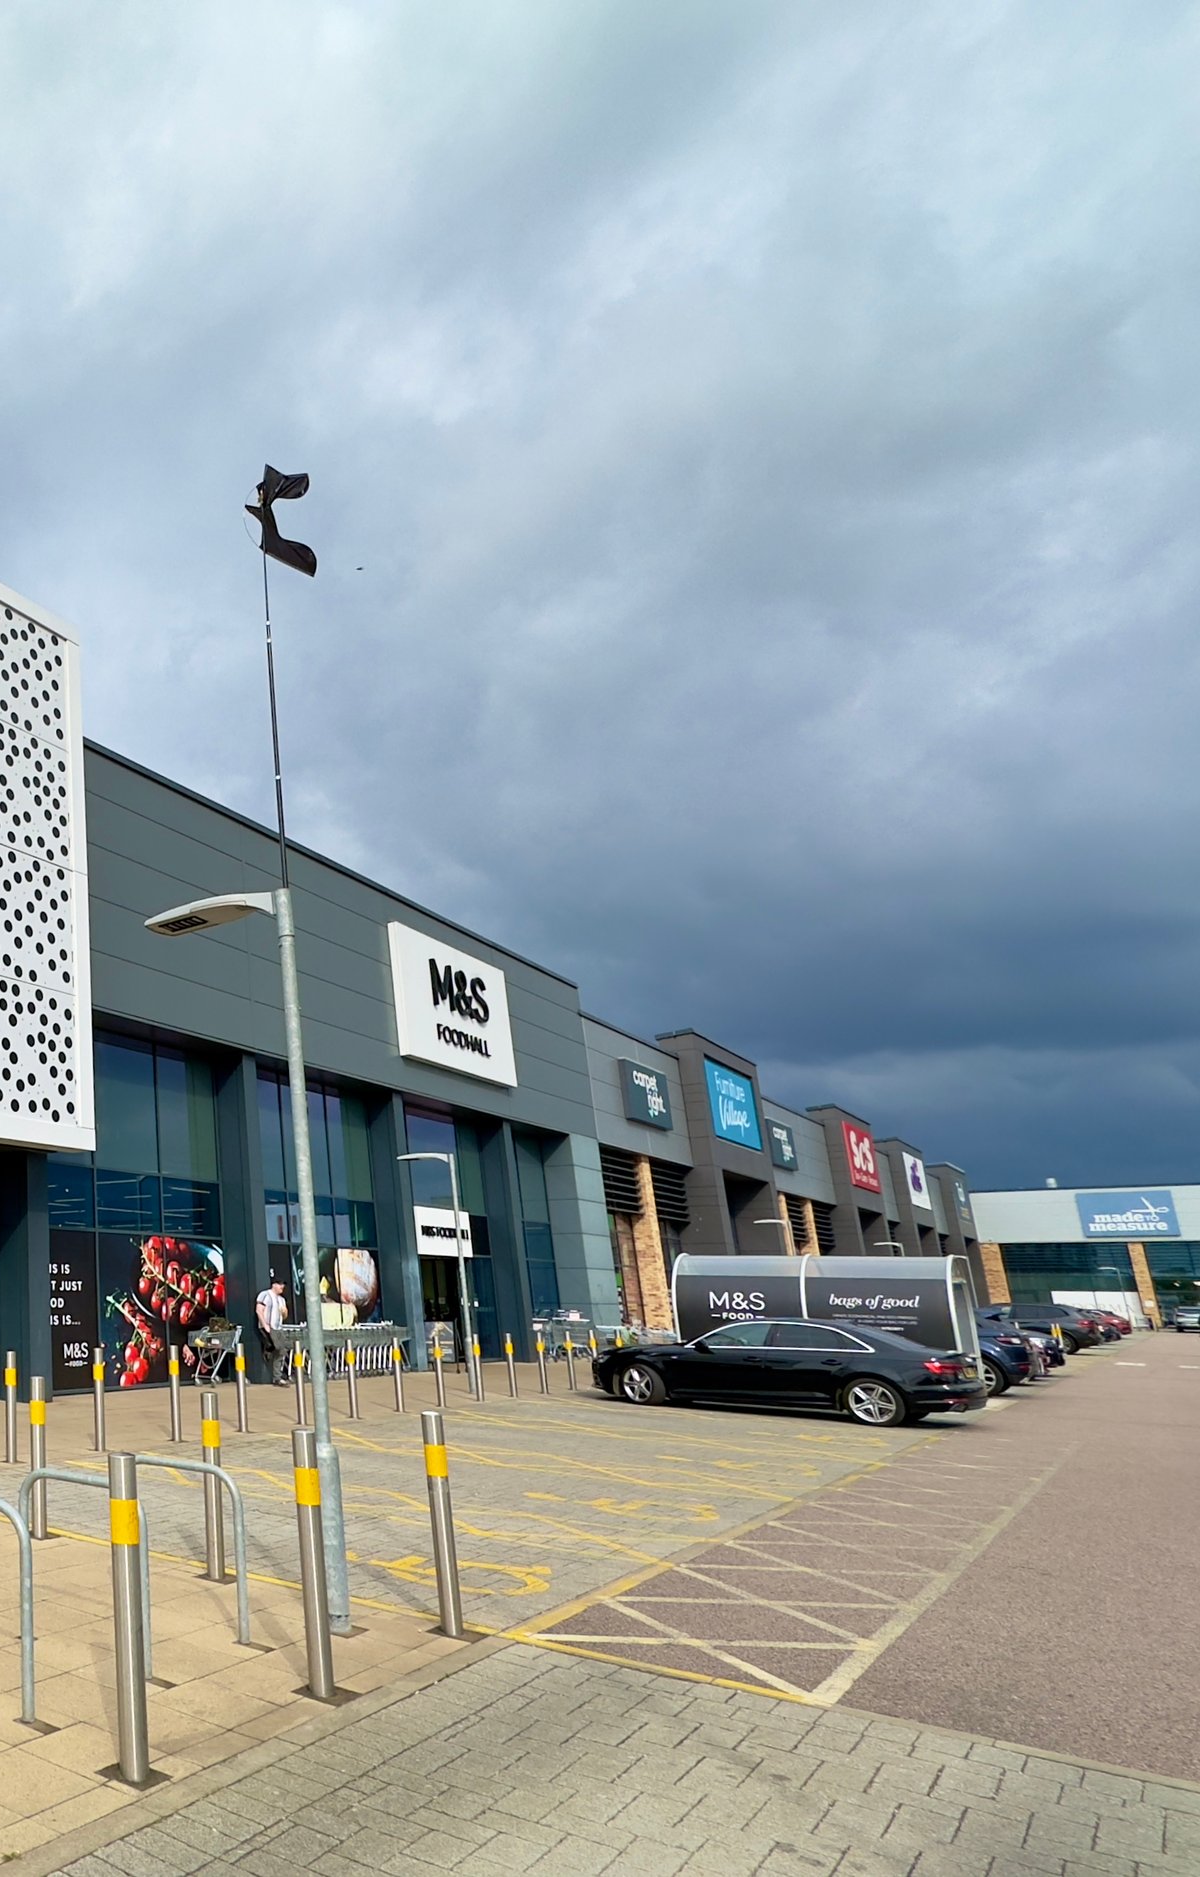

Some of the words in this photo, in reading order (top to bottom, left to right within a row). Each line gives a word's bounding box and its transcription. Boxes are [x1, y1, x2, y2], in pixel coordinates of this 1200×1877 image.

[429, 958, 490, 1024] M&S
[436, 1023, 491, 1058] FOODHALL
[632, 1070, 658, 1096] carpet
[714, 1071, 745, 1103] Furniture
[719, 1095, 751, 1137] Village
[1093, 1211, 1144, 1223] made
[1088, 1221, 1168, 1232] measure
[49, 1263, 58, 1274] IS
[61, 1264, 71, 1274] IS
[59, 1280, 83, 1292] JUST
[50, 1297, 65, 1309] OD
[709, 1291, 766, 1311] M&S
[829, 1293, 862, 1310] bags
[865, 1294, 884, 1310] of
[881, 1295, 920, 1310] good
[50, 1314, 60, 1326] IS
[722, 1312, 754, 1320] FOOD
[63, 1342, 89, 1359] M&S
